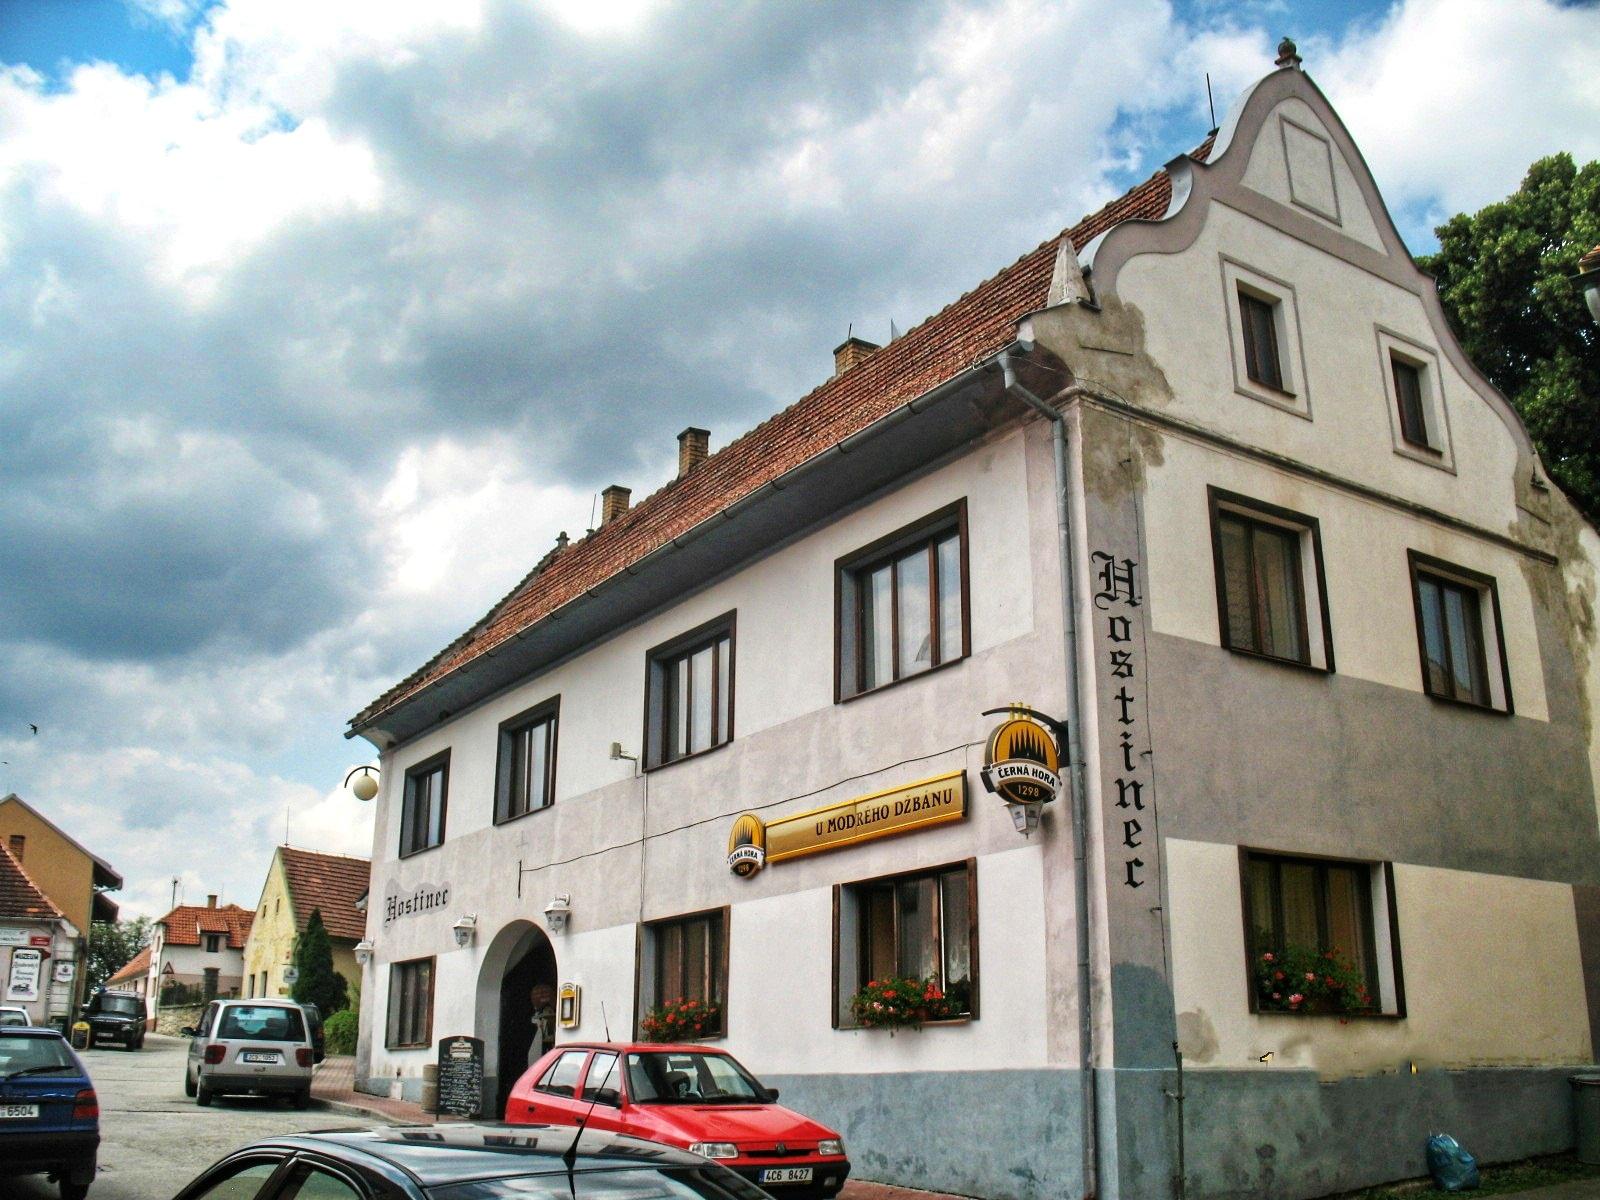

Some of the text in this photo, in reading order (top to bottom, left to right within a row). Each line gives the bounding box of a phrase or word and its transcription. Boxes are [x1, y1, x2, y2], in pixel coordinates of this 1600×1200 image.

[1091, 551, 1145, 889] Hostinec
[997, 764, 1055, 788] ČERNÁ HORA
[1018, 784, 1040, 797] 1298
[815, 788, 953, 836] U MODRÉHO DŽBÁNU
[743, 850, 758, 860] HORA
[384, 889, 448, 925] Hostinec
[7, 1105, 34, 1117] 6504
[765, 1169, 809, 1181] 4C6 8427
